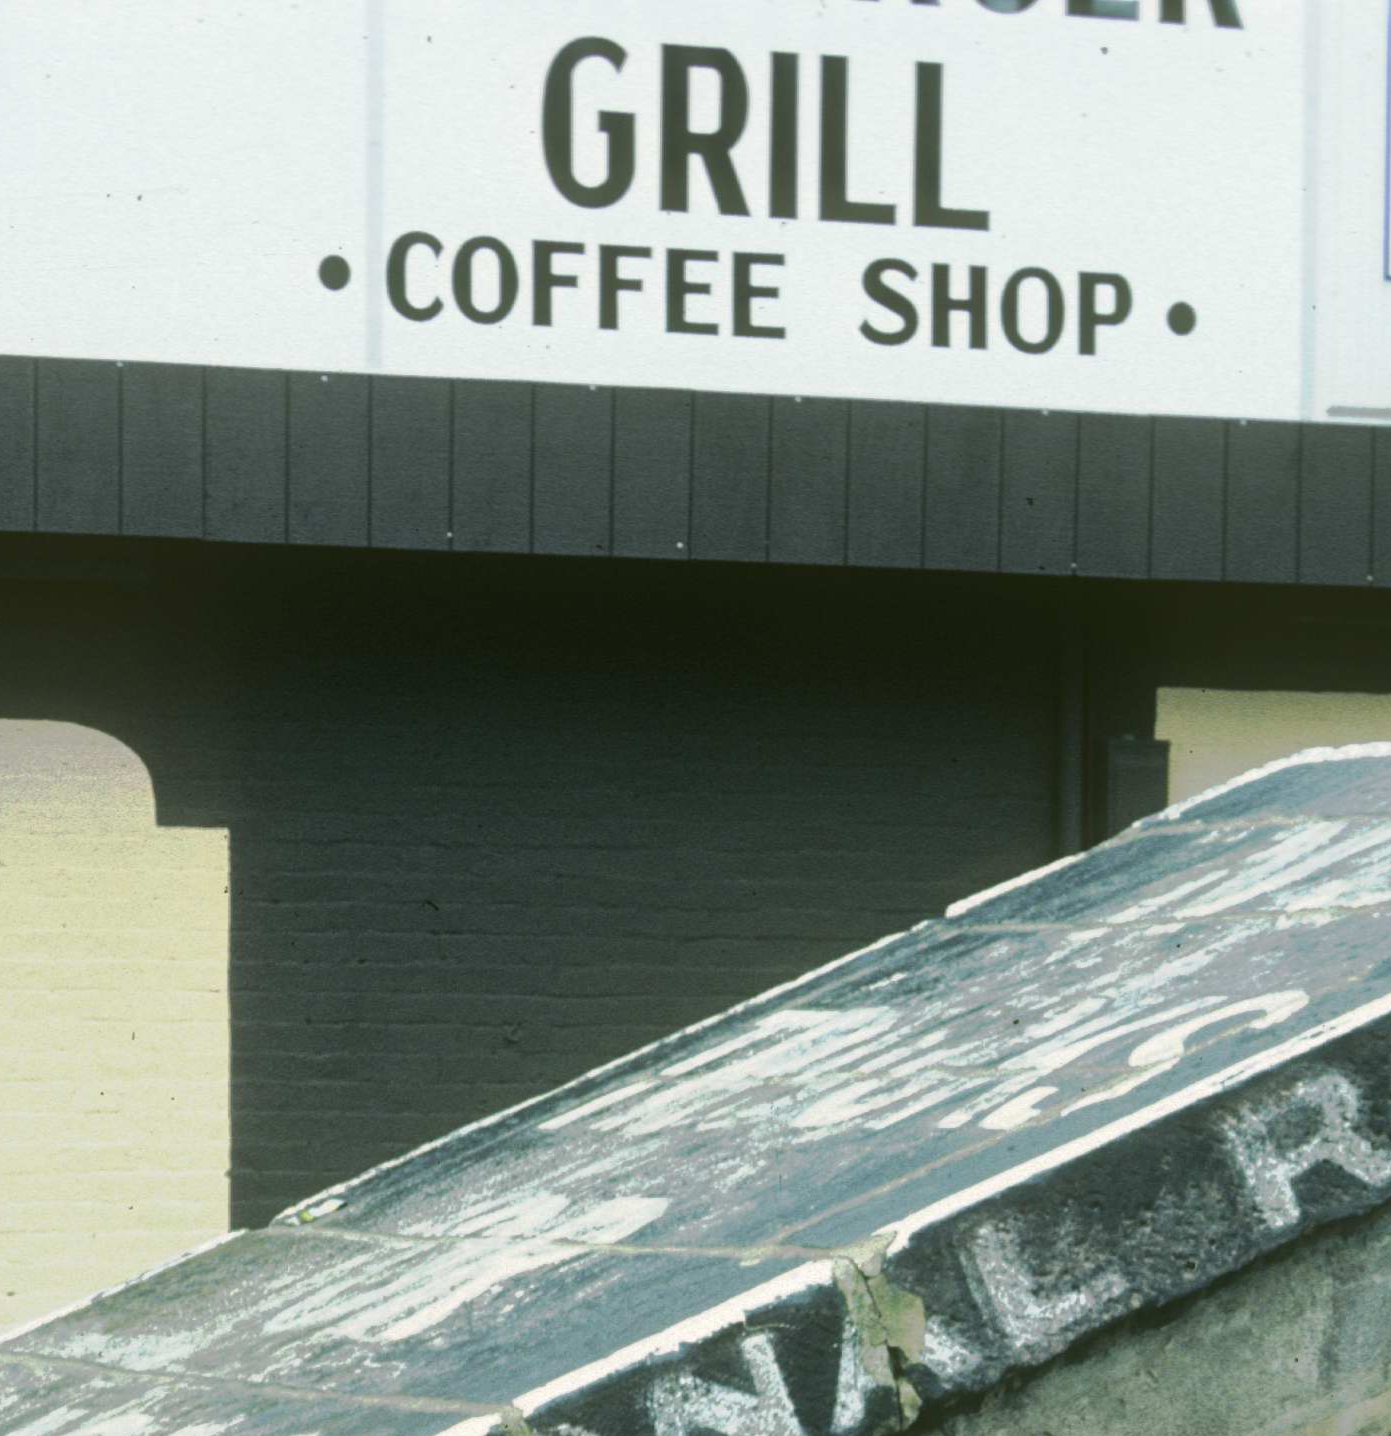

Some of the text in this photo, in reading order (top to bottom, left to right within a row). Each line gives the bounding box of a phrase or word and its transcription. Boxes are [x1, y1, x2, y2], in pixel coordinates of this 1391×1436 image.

[541, 36, 990, 231] GRILL
[385, 230, 1133, 356] COFFEE SHOP
